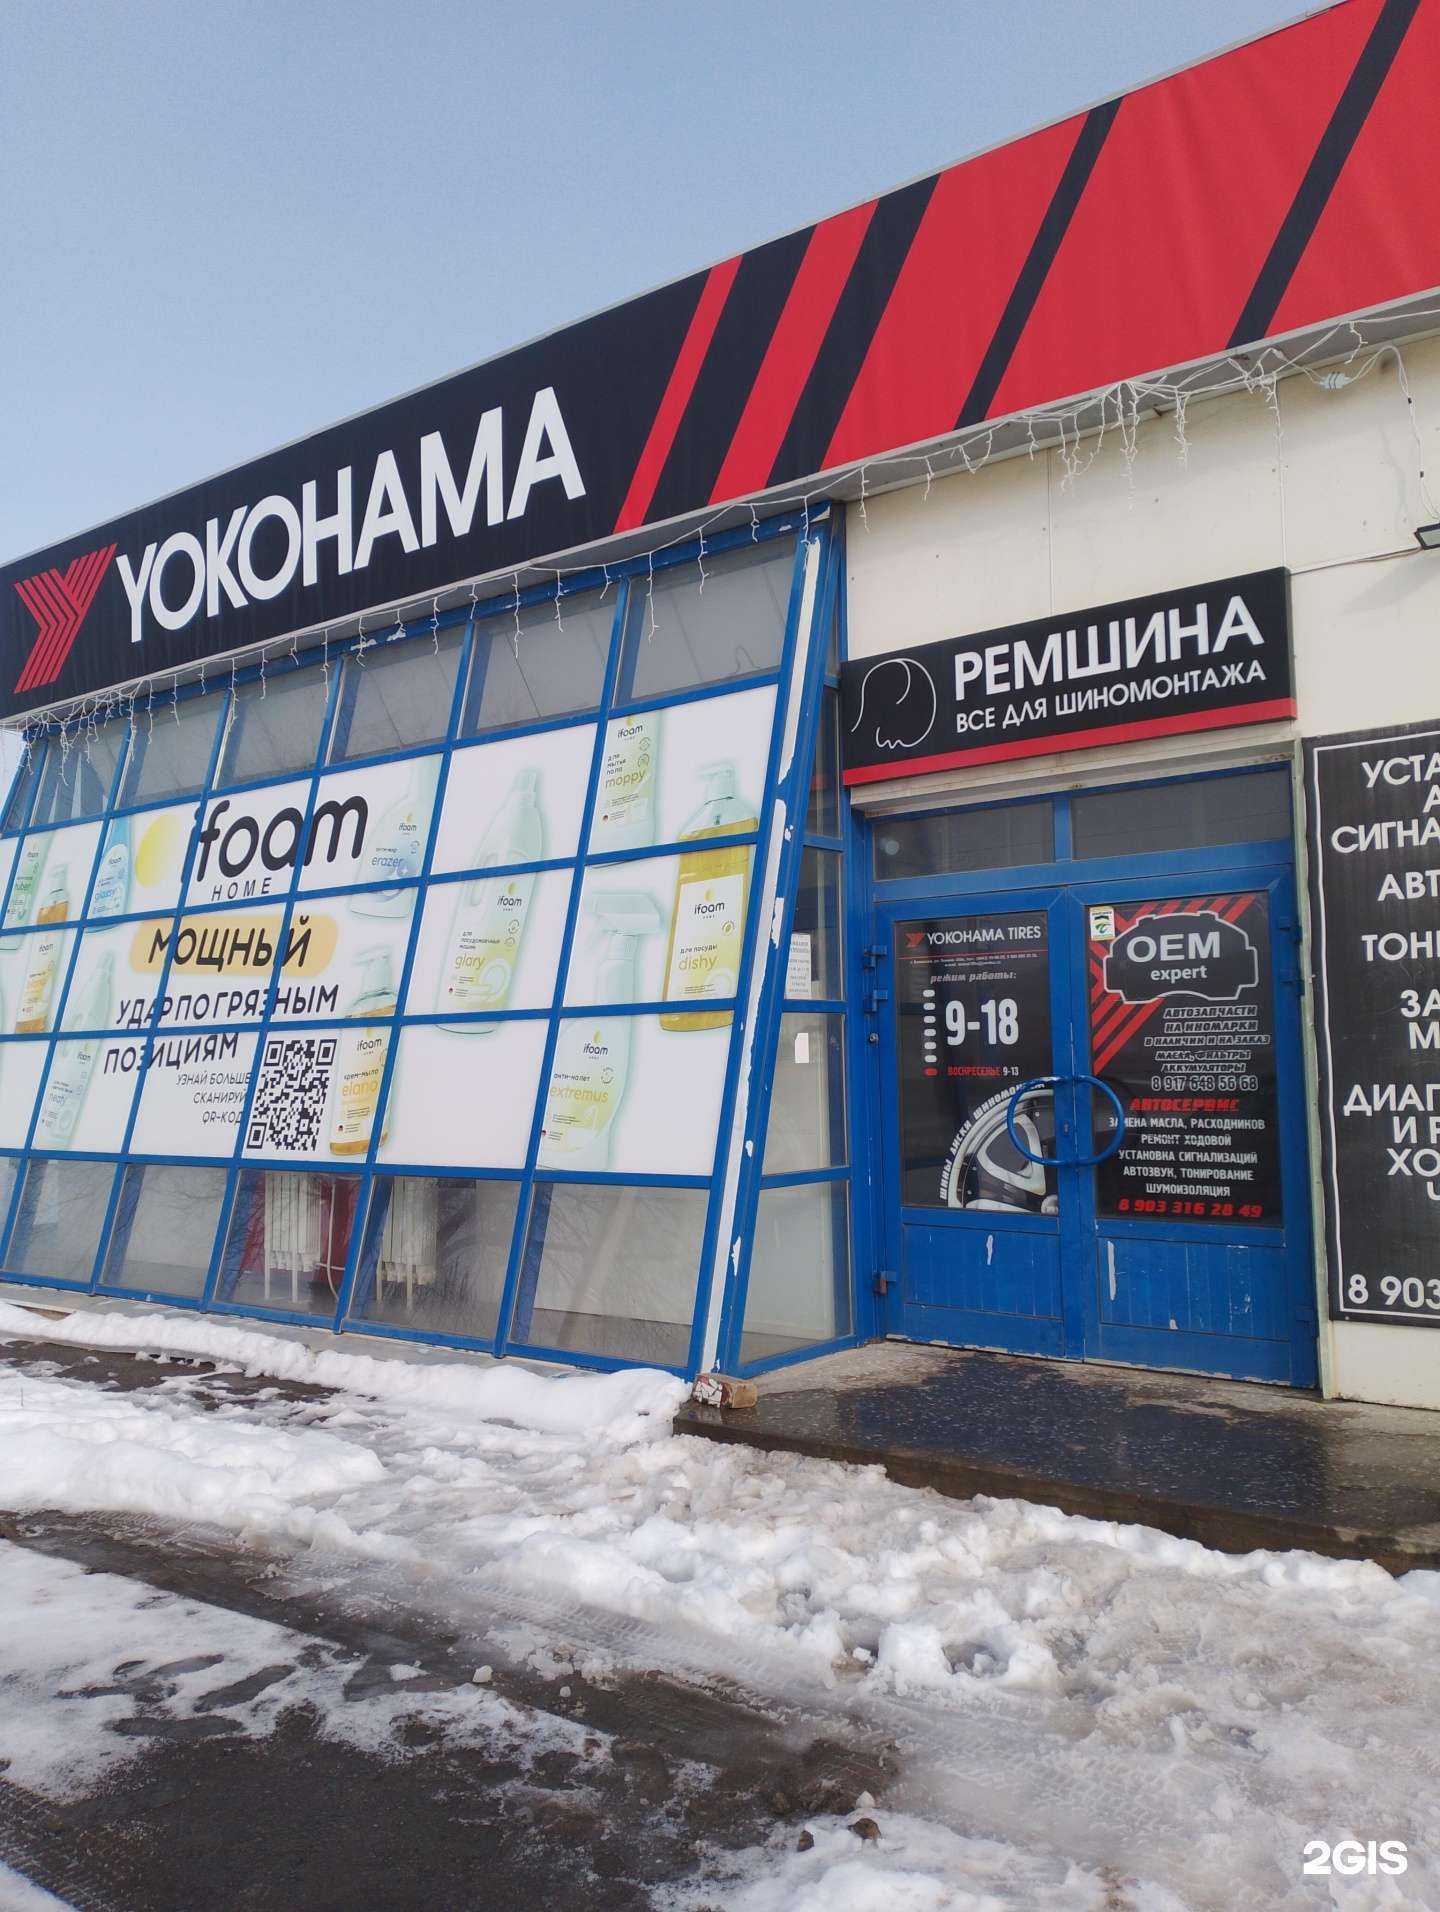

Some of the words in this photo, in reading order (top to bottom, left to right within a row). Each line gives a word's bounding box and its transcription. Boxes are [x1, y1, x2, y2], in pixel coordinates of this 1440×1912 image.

[116, 386, 587, 644] YOKOHAMA
[953, 594, 1265, 701] РЕМШИНА
[956, 706, 996, 734] ВСЕ
[1002, 696, 1048, 729] ДЛЯ
[1055, 659, 1267, 716] ШИНОМОНТАЖА
[1331, 816, 1440, 854] СИГНА
[211, 877, 272, 901] HOME
[1377, 869, 1440, 902] АВТ
[694, 902, 725, 915] ifoam
[927, 928, 1004, 945] YOKOHAMA
[1008, 926, 1042, 940] TIRES
[1126, 931, 1221, 963] OEM
[679, 955, 718, 971] dishy
[930, 973, 967, 984] режим
[1150, 966, 1208, 984] expert
[1163, 1005, 1257, 1019] АВТОЗАПЧАСТИ
[945, 999, 1019, 1046] 9-18
[1164, 1022, 1182, 1034] НА
[1184, 1020, 1258, 1033] ИНОМАРКИ
[1002, 1065, 1019, 1076] 9-13
[1161, 1062, 1246, 1073] АККУМУЛЯТОРЫ
[176, 1070, 208, 1086] УЗНАЙ
[1152, 1076, 1161, 1091] 8
[1164, 1076, 1186, 1091] 917
[1190, 1076, 1215, 1091] 648
[1218, 1076, 1236, 1091] 56
[550, 1085, 609, 1103] extremus
[1130, 1097, 1240, 1112] АВТОСЕРВИС
[1150, 1117, 1187, 1130] МАСЛА,
[1190, 1119, 1266, 1131] РАСХОДНИКОВ
[1393, 1116, 1418, 1144] И
[1141, 1134, 1181, 1145] РЕМОНТ
[1184, 1133, 1232, 1146] ХОДОВОЙ
[1118, 1149, 1176, 1162] УСТАНОВКА
[1178, 1150, 1258, 1164] СИГНАЛИЗАЦИЙ
[1386, 1148, 1440, 1177] ХО
[1123, 1166, 1178, 1180] АВТОЗВУК,
[1181, 1167, 1254, 1181] ТОНИРОВАНИЕ
[1146, 1182, 1231, 1197] ШУМОИЗОЛЯЦИЯ
[1118, 1199, 1130, 1212] 8
[1133, 1200, 1168, 1213] 903
[1172, 1201, 1206, 1215] 316
[1210, 1203, 1234, 1217] 28
[1238, 1204, 1264, 1218] 49
[1348, 1273, 1369, 1304] 8
[1379, 1275, 1440, 1311] 903
